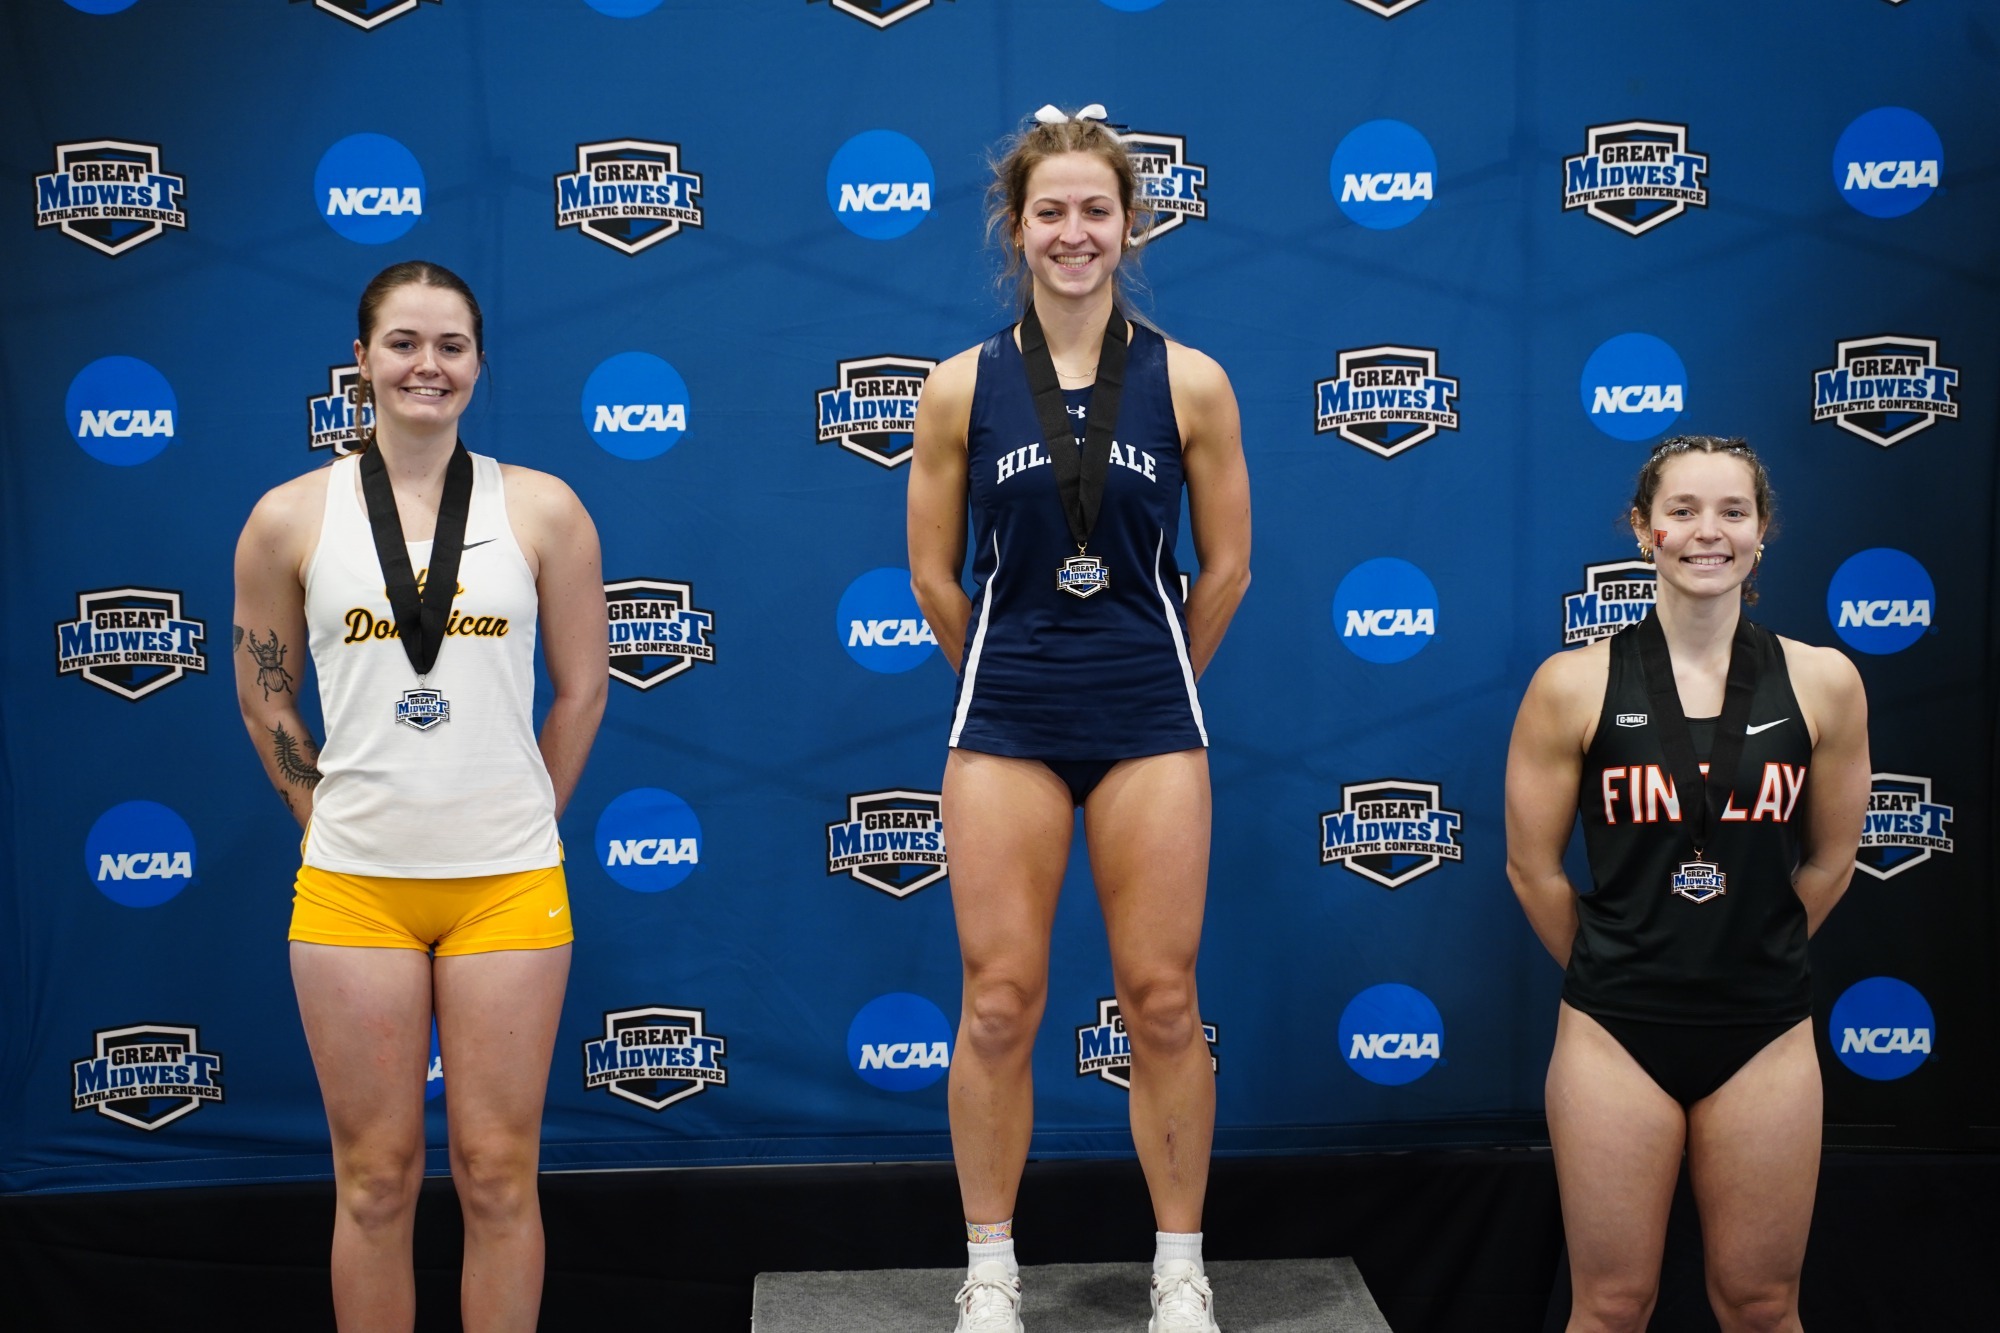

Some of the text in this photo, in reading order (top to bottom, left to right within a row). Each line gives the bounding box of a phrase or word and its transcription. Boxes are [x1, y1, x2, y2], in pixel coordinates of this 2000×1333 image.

[1602, 145, 1669, 164] GREAT
[73, 163, 144, 183] GREAT
[594, 163, 662, 182] GREAT
[1568, 154, 1705, 193] MIDWEST
[1844, 160, 1938, 190] NCAA
[39, 173, 181, 211] MIDWEST
[559, 173, 698, 211] MIDWEST
[838, 182, 931, 212] NCAA
[1341, 172, 1433, 202] NCAA
[1568, 186, 1704, 205] ATHLETIC CONFERENCE
[327, 187, 422, 216] NCAA
[40, 205, 183, 224] ATHLETIC CONFERENCE
[561, 205, 699, 222] ATHLETIC CONFERENCE
[1852, 357, 1920, 377] GREAT
[1353, 369, 1420, 388] GREAT
[1817, 367, 1956, 405] MIDWEST
[855, 380, 922, 398] GREAT
[1319, 378, 1455, 417] MIDWEST
[821, 390, 920, 426] MIDWE
[1591, 385, 1683, 414] NCAA
[1817, 399, 1956, 417] ATHLETIC CONFERENCE
[78, 410, 174, 437] NCAA
[593, 404, 687, 433] NCAA
[1320, 409, 1454, 428] ATHLETIC CONFERENCE
[822, 420, 878, 438] ATHLETIC
[996, 438, 1157, 485] HILALE
[1059, 568, 1107, 582] MIDWEST
[1071, 565, 1095, 573] GREAT
[1602, 583, 1657, 601] GREA
[95, 611, 165, 630] GREAT
[608, 603, 675, 621] GREAT
[1568, 593, 1657, 630] MIDW
[1838, 599, 1931, 628] NCAA
[344, 607, 509, 644] Doican
[609, 611, 709, 645] IDWEST
[848, 618, 939, 647] NCAA
[1344, 608, 1435, 637] NCAA
[60, 620, 201, 658] MIDWEST
[635, 642, 710, 657] CONFERENCE
[62, 651, 202, 669] ATHLETIC CONFERENCE
[398, 701, 447, 714] MIDWEST
[410, 697, 435, 705] GREAT
[1602, 762, 1807, 825] FINLAY
[1866, 794, 1917, 811] REAT
[1358, 802, 1424, 820] GREAT
[865, 812, 931, 831] GREAT
[1324, 812, 1459, 848] MIDWEST
[831, 821, 946, 858] MIDWES
[1325, 841, 1458, 858] ATHLETIC CONFERENCE
[1877, 834, 1951, 849] CONFERENCE
[607, 838, 699, 866] NCAA
[832, 851, 947, 869] ATHLETIC CONFERE
[97, 851, 192, 881] NCAA
[1686, 870, 1711, 878] GREAT
[1674, 874, 1723, 887] MIDWEST
[620, 1029, 688, 1047] GREAT
[1349, 1033, 1440, 1059] NCAA
[1841, 1028, 1931, 1054] NCAA
[111, 1046, 179, 1066] GREAT
[587, 1037, 724, 1075] MIDWEST
[859, 1042, 950, 1070] NCAA
[1082, 1055, 1130, 1071] ATHLETI
[76, 1054, 218, 1096] MIDWEST
[589, 1067, 723, 1086] ATHLETIC CONFERENCE
[77, 1085, 220, 1106] ATHLETIC CONFERENCE
